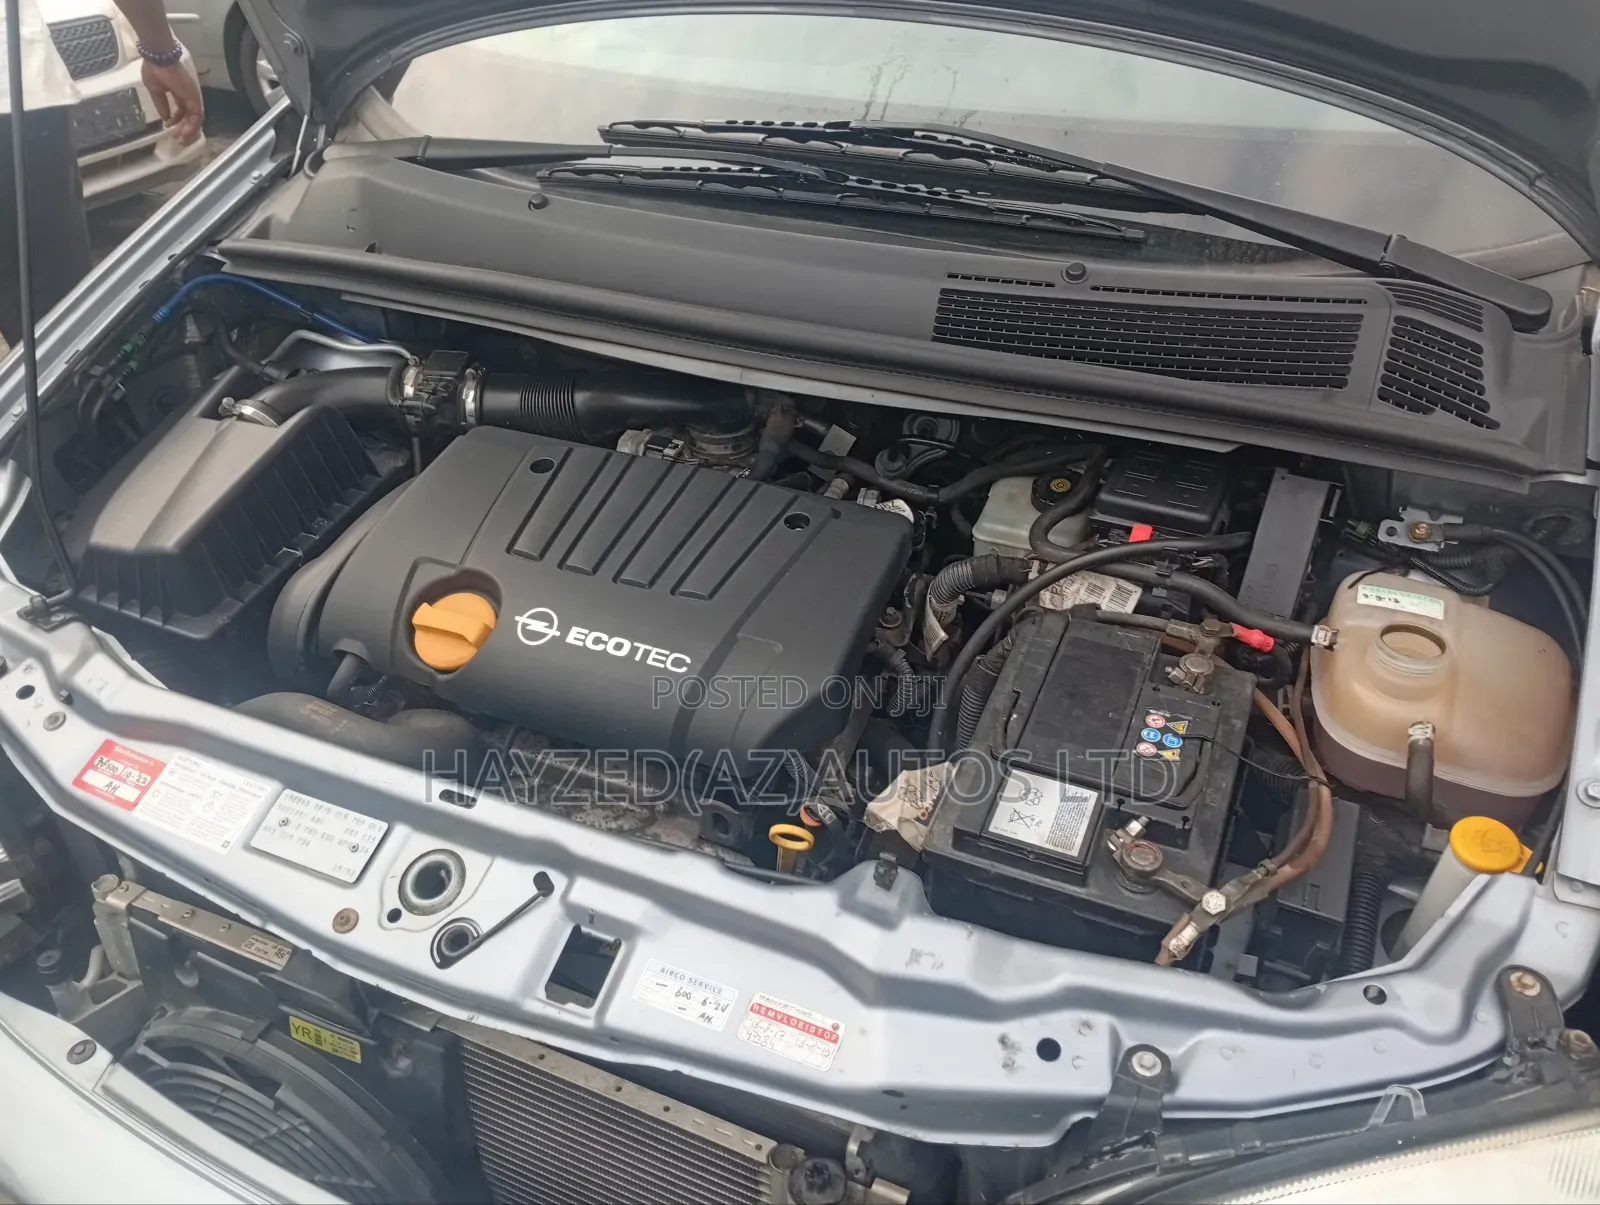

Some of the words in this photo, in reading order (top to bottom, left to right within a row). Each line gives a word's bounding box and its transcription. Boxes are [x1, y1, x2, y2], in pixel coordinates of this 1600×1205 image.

[565, 626, 691, 673] ECOTEC
[660, 967, 686, 981] AIRCO
[687, 977, 723, 995] SERVICE
[291, 1021, 313, 1041] YR
[752, 1003, 838, 1042] REMVLOEISTOF
